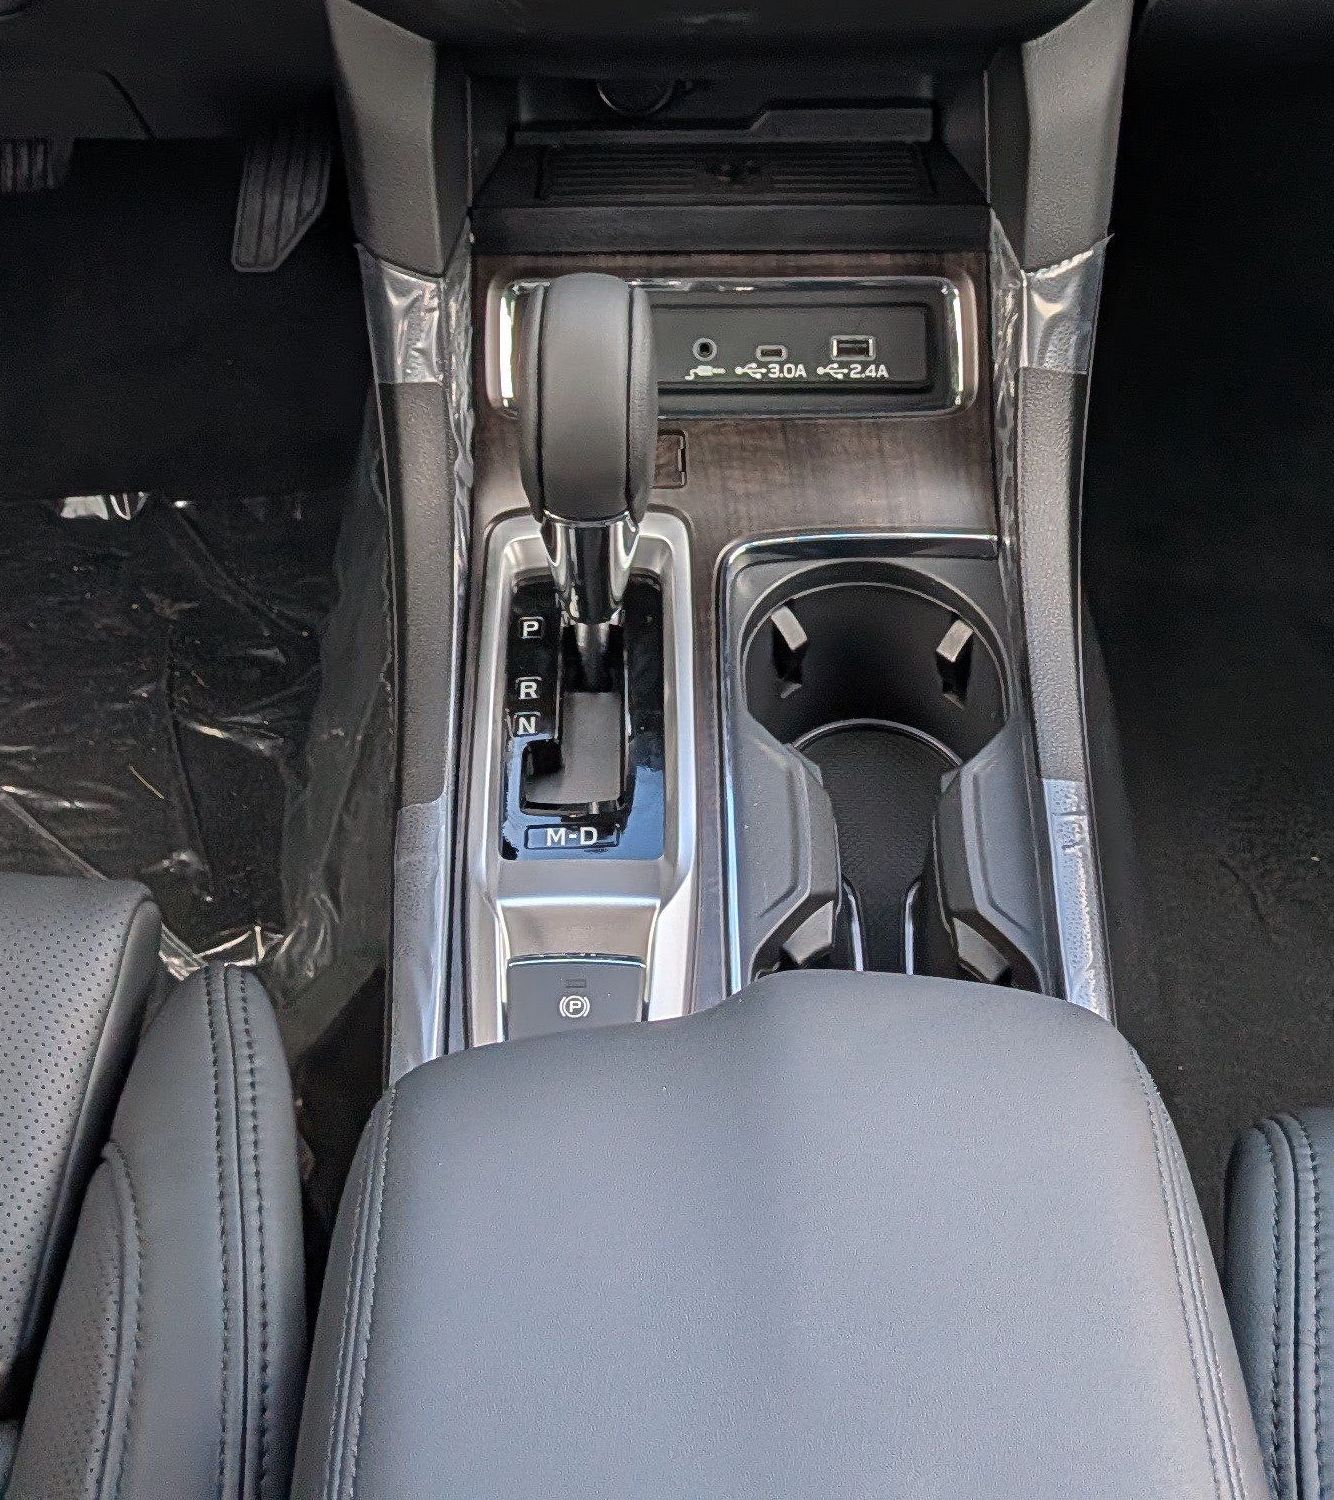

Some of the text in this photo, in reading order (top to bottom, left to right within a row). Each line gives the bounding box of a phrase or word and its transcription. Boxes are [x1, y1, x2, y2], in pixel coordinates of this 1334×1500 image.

[768, 363, 890, 379] 3.0A 2.4A
[523, 621, 539, 636] P
[520, 682, 537, 699] R
[518, 717, 535, 734] N
[546, 827, 598, 847] M-D
